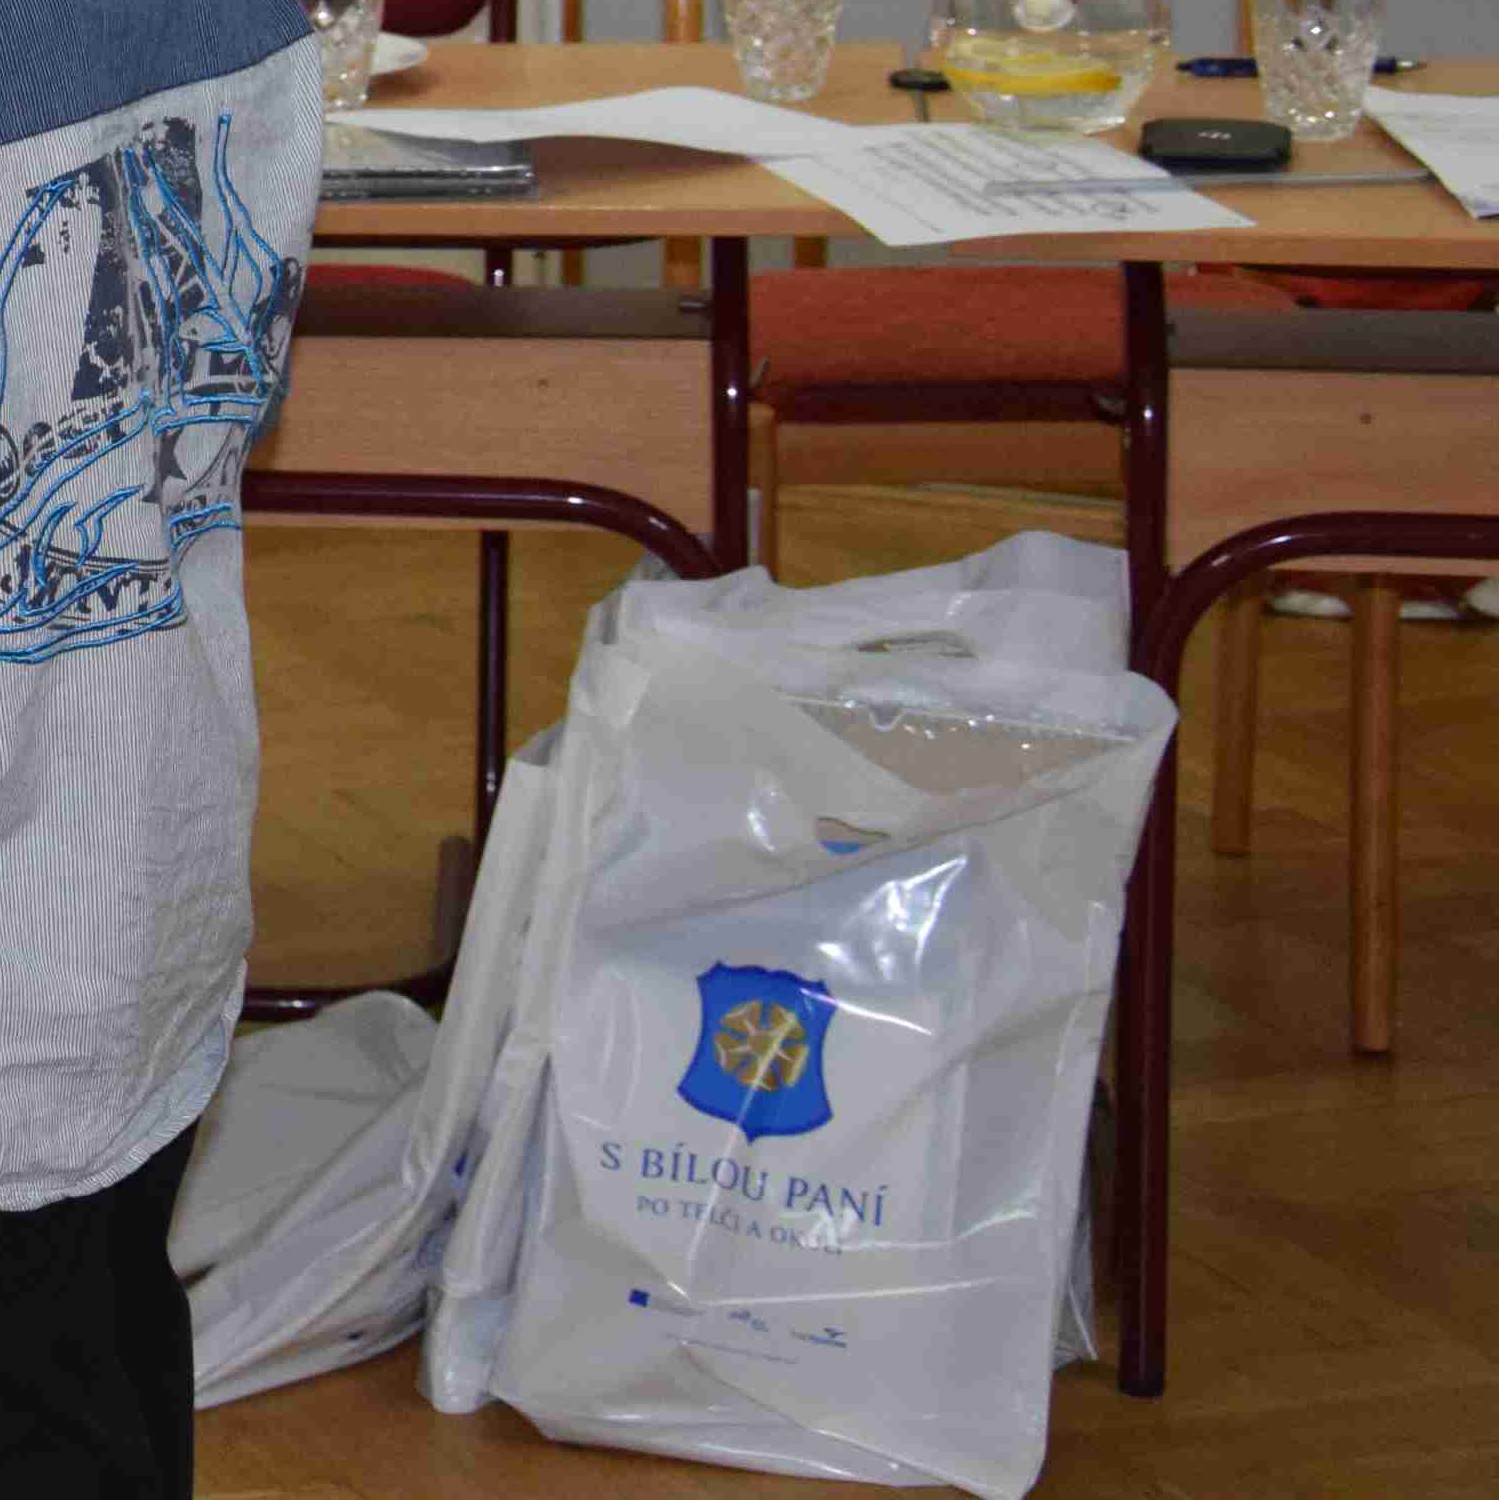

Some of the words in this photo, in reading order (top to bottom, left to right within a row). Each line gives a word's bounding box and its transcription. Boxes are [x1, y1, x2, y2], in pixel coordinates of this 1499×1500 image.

[599, 1141, 623, 1172] S
[640, 1142, 769, 1202] BÍLOU
[784, 1174, 890, 1227] PANÍ
[636, 1194, 670, 1218] PO
